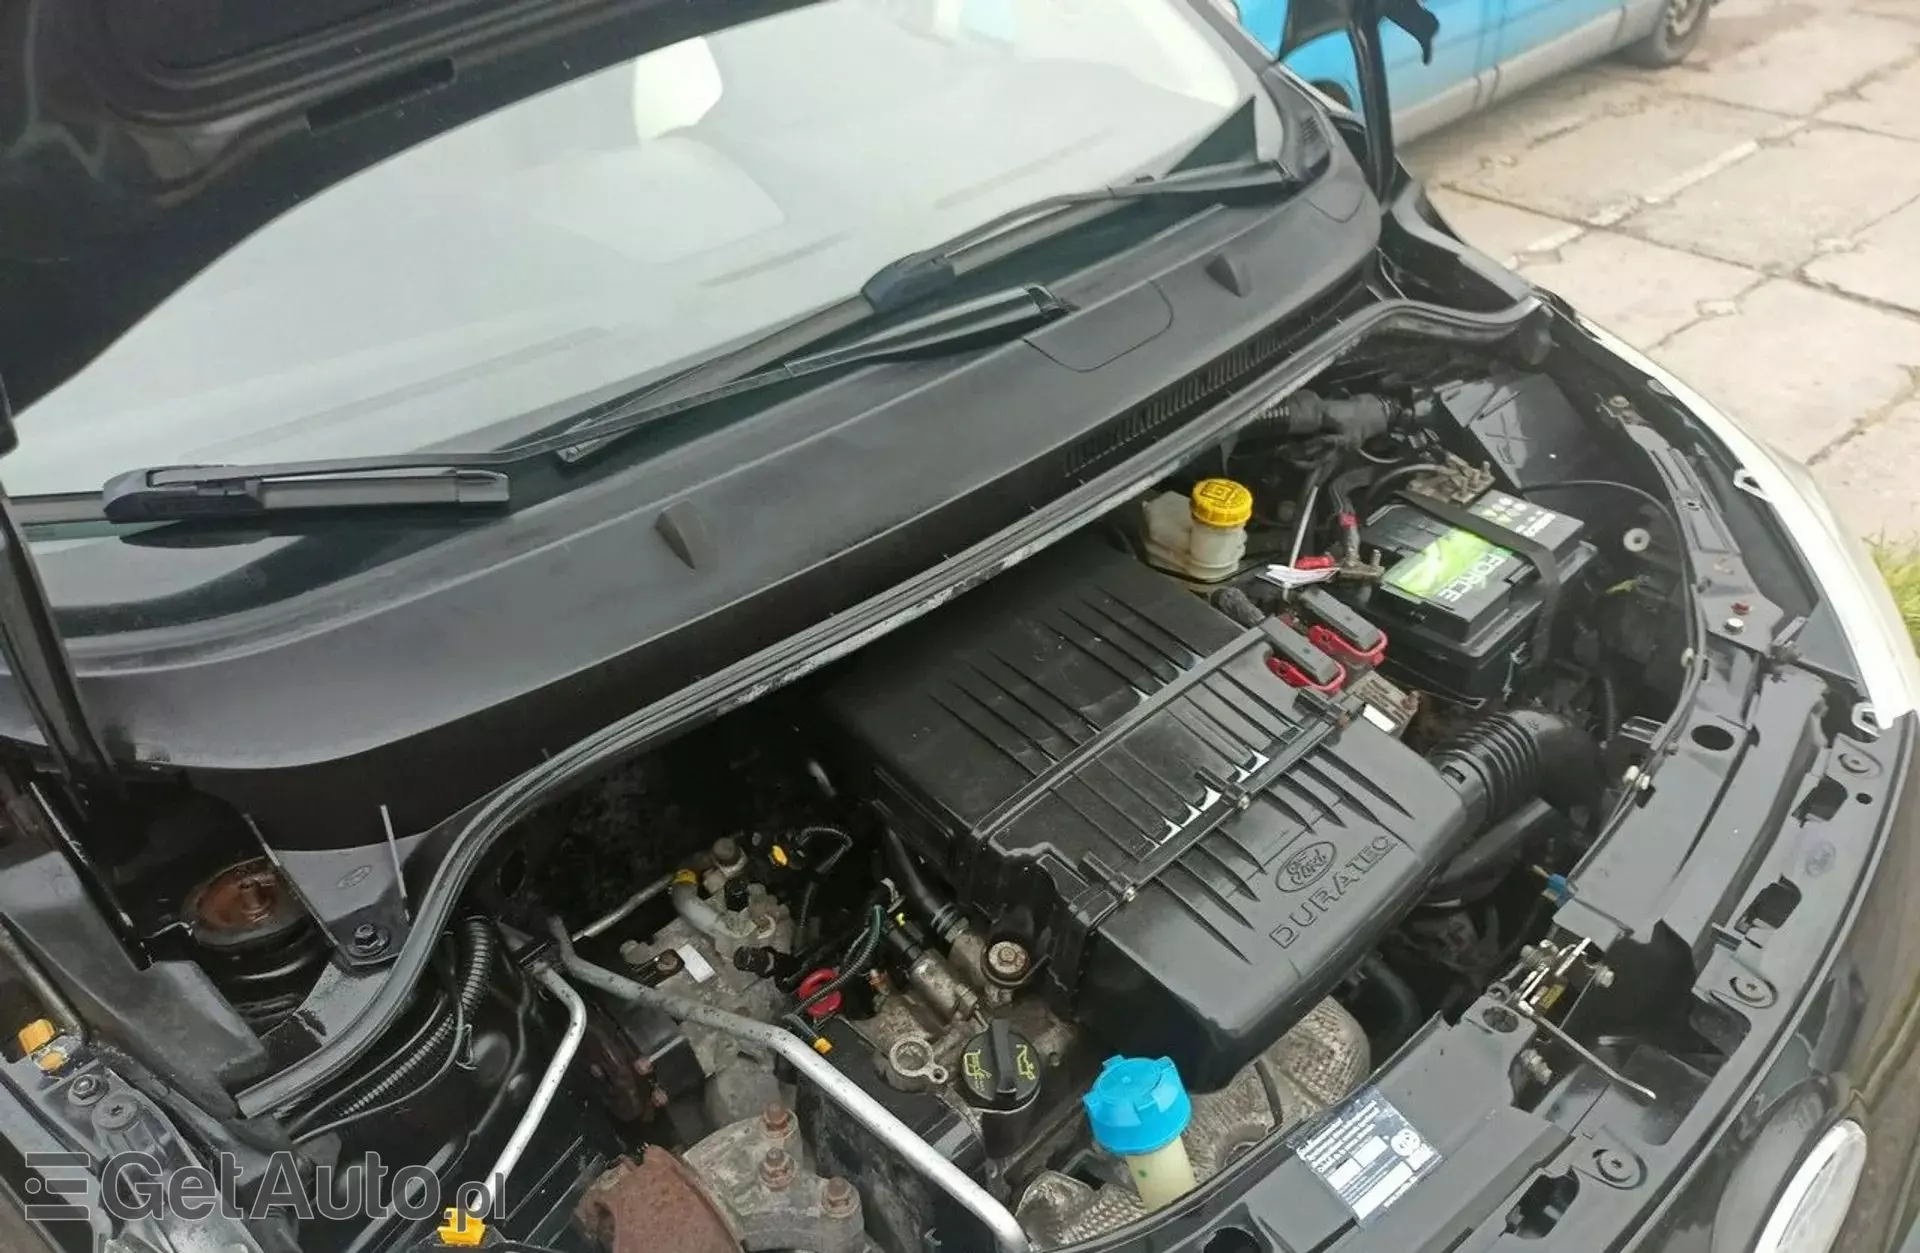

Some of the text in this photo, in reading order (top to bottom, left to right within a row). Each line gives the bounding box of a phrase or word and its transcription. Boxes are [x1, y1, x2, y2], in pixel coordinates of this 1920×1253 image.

[1438, 552, 1506, 602] FORCE
[1269, 836, 1397, 949] DURATEC
[1285, 848, 1327, 887] Ford
